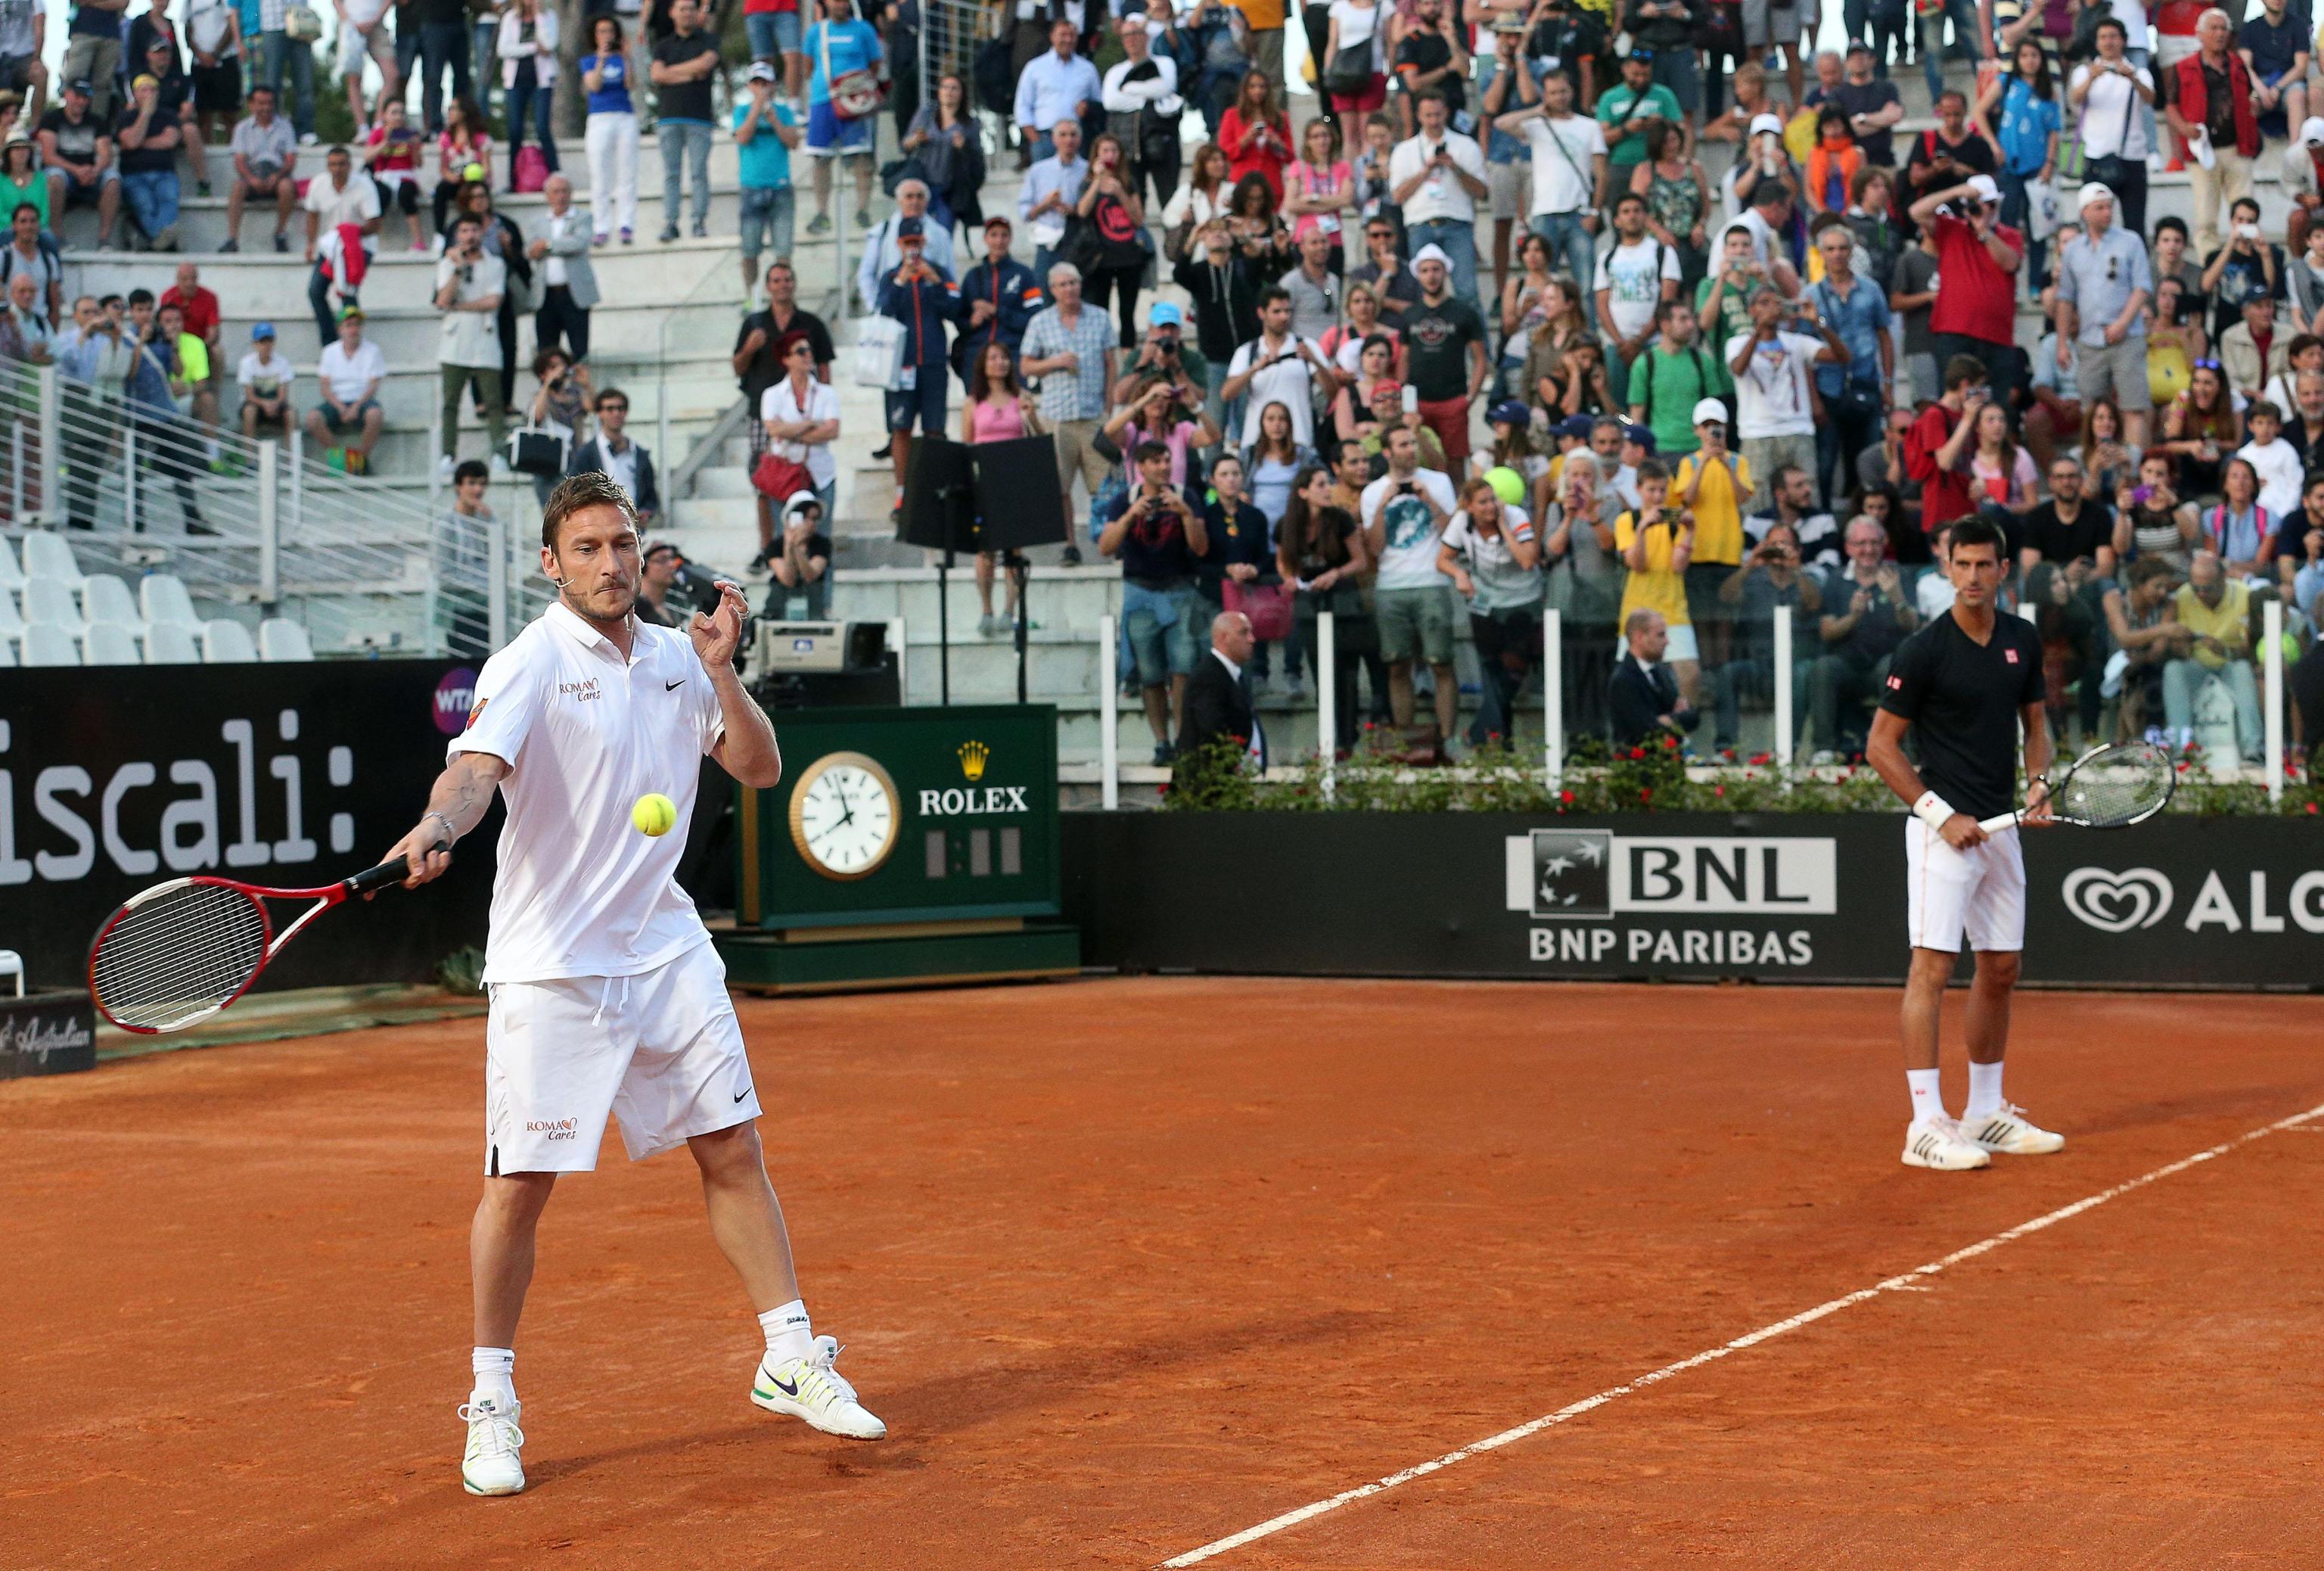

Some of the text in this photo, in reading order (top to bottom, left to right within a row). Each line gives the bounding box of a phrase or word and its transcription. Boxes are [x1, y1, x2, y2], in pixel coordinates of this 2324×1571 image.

[559, 681, 591, 694] ROMA
[577, 690, 601, 702] Cares
[918, 786, 1030, 816] ROLEX
[1630, 847, 1810, 902] BNL
[1529, 928, 1814, 966] BNP PARIBAS
[527, 1120, 564, 1131] ROMA
[548, 1130, 576, 1140] Cares
